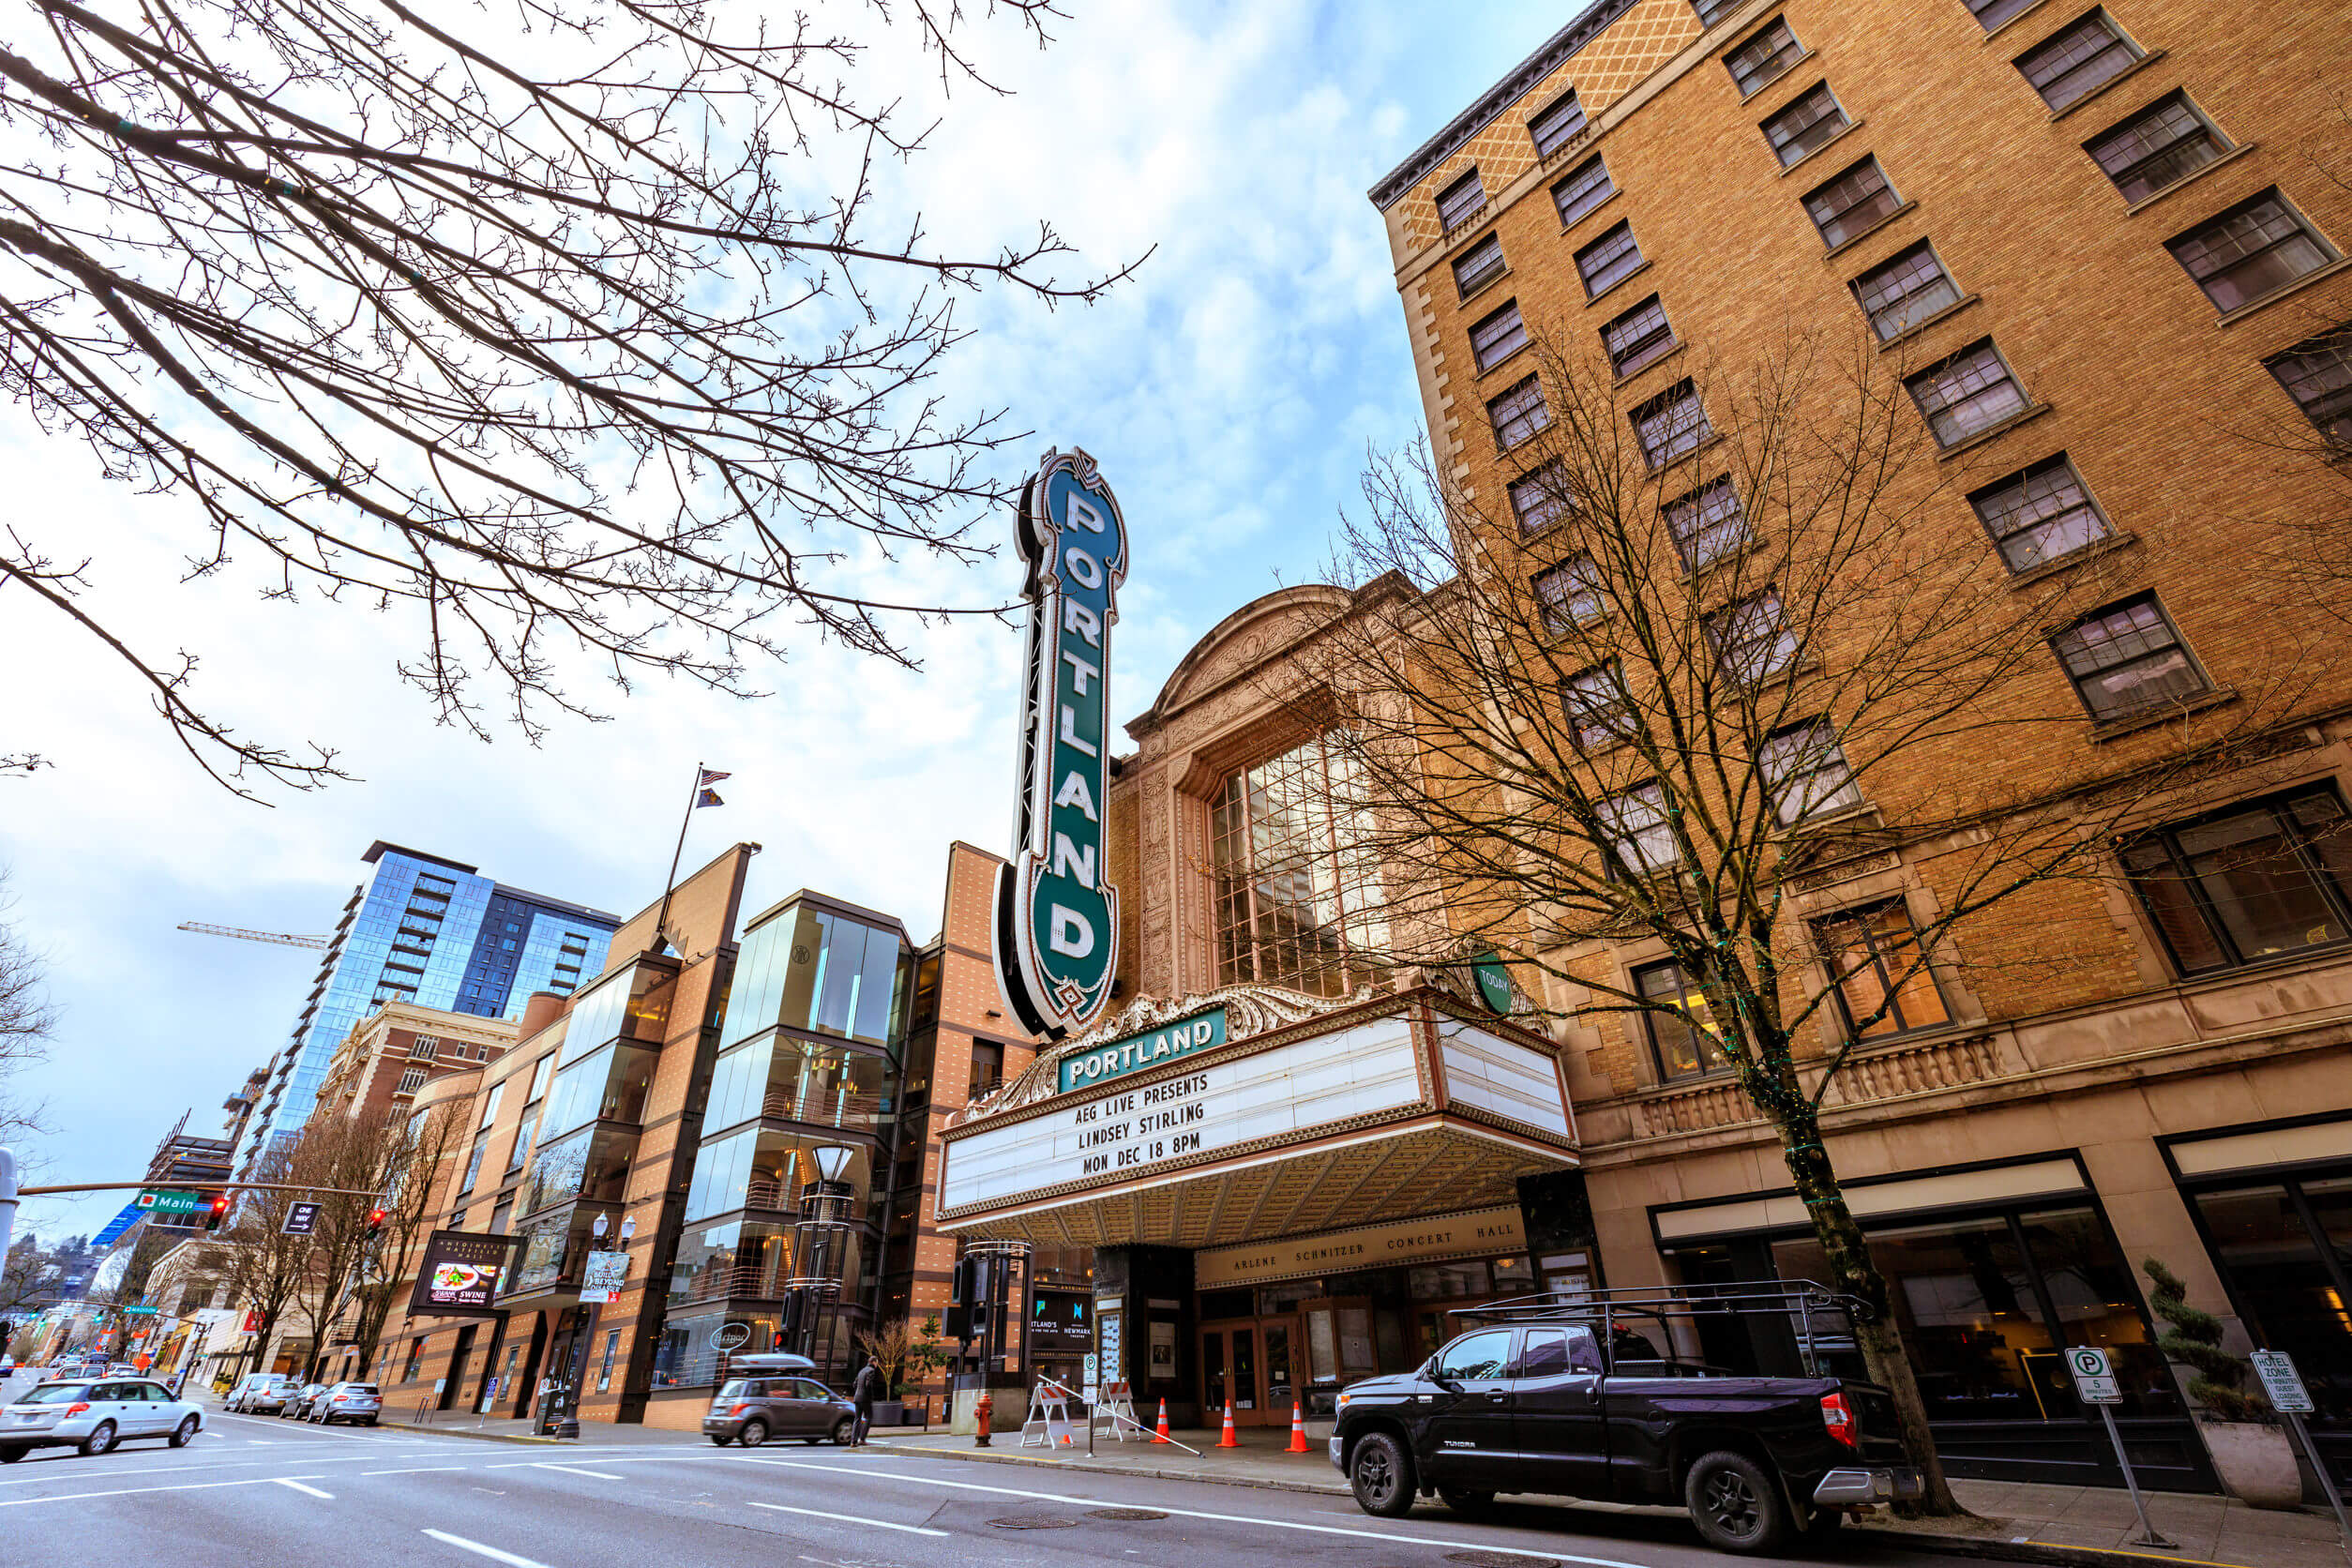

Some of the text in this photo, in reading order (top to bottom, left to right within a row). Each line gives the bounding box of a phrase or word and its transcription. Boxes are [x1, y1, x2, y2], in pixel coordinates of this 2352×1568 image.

[1050, 490, 1105, 958] PORTLAND
[1481, 969, 1508, 991] TODAY
[1069, 1020, 1213, 1085] PORTLAND
[1076, 1074, 1207, 1124] AEG LIVE PRESENTS
[1078, 1102, 1204, 1149] LINDSEY STIRLING
[1083, 1132, 1200, 1174] MON DEC 18 8PM
[158, 1197, 193, 1209] Main
[1234, 1223, 1514, 1271] ARLENE SCHNITZER CONCERT HALL
[594, 1277, 626, 1287] BEYOND
[460, 1291, 488, 1300] SWINE
[1063, 1327, 1092, 1335] NEWMARK
[2081, 1356, 2096, 1370] P
[2256, 1357, 2289, 1367] HOTEL
[2264, 1367, 2292, 1378] ZONE
[2092, 1380, 2101, 1389] 5
[1443, 1440, 1476, 1448] TUNDRA
